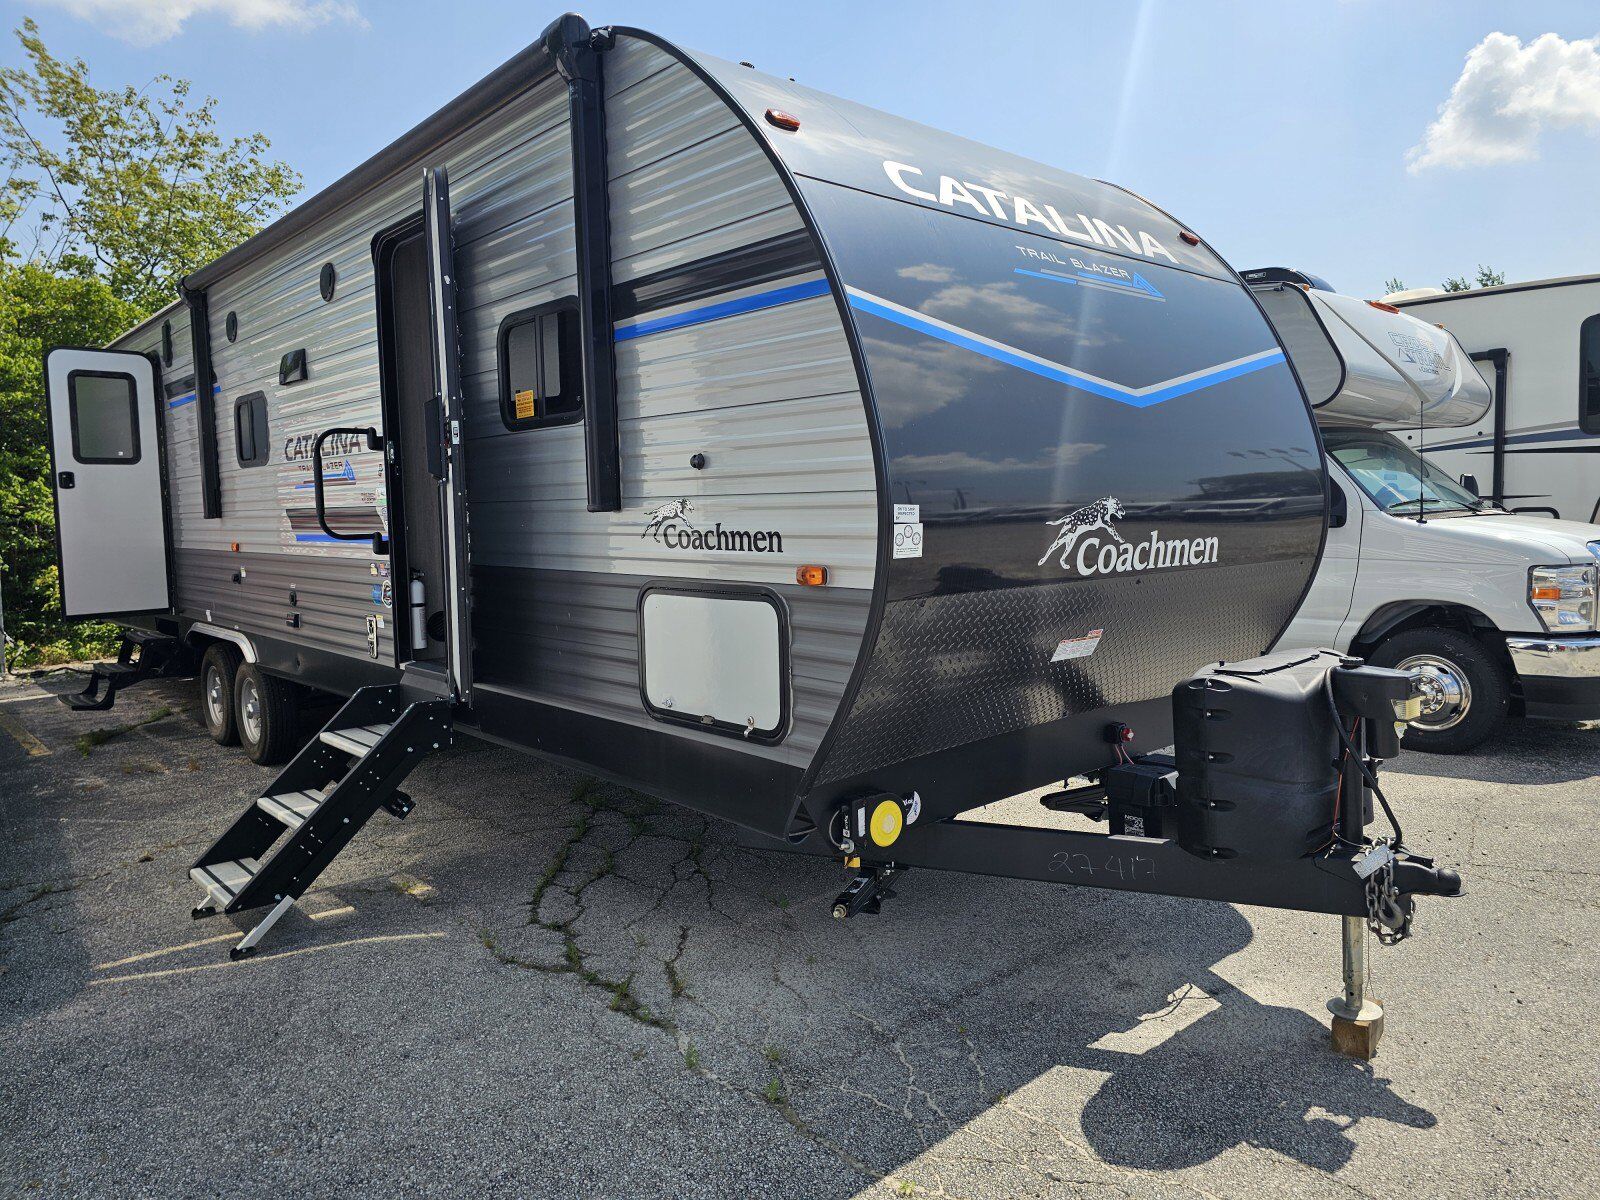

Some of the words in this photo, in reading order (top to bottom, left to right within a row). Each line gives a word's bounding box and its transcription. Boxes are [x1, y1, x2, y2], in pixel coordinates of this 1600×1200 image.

[882, 159, 1180, 265] CATALINA
[1015, 245, 1066, 266] TRAIL
[1070, 257, 1132, 280] BLAZER
[663, 522, 784, 554] Coachmen
[1077, 530, 1218, 576] Coachmen
